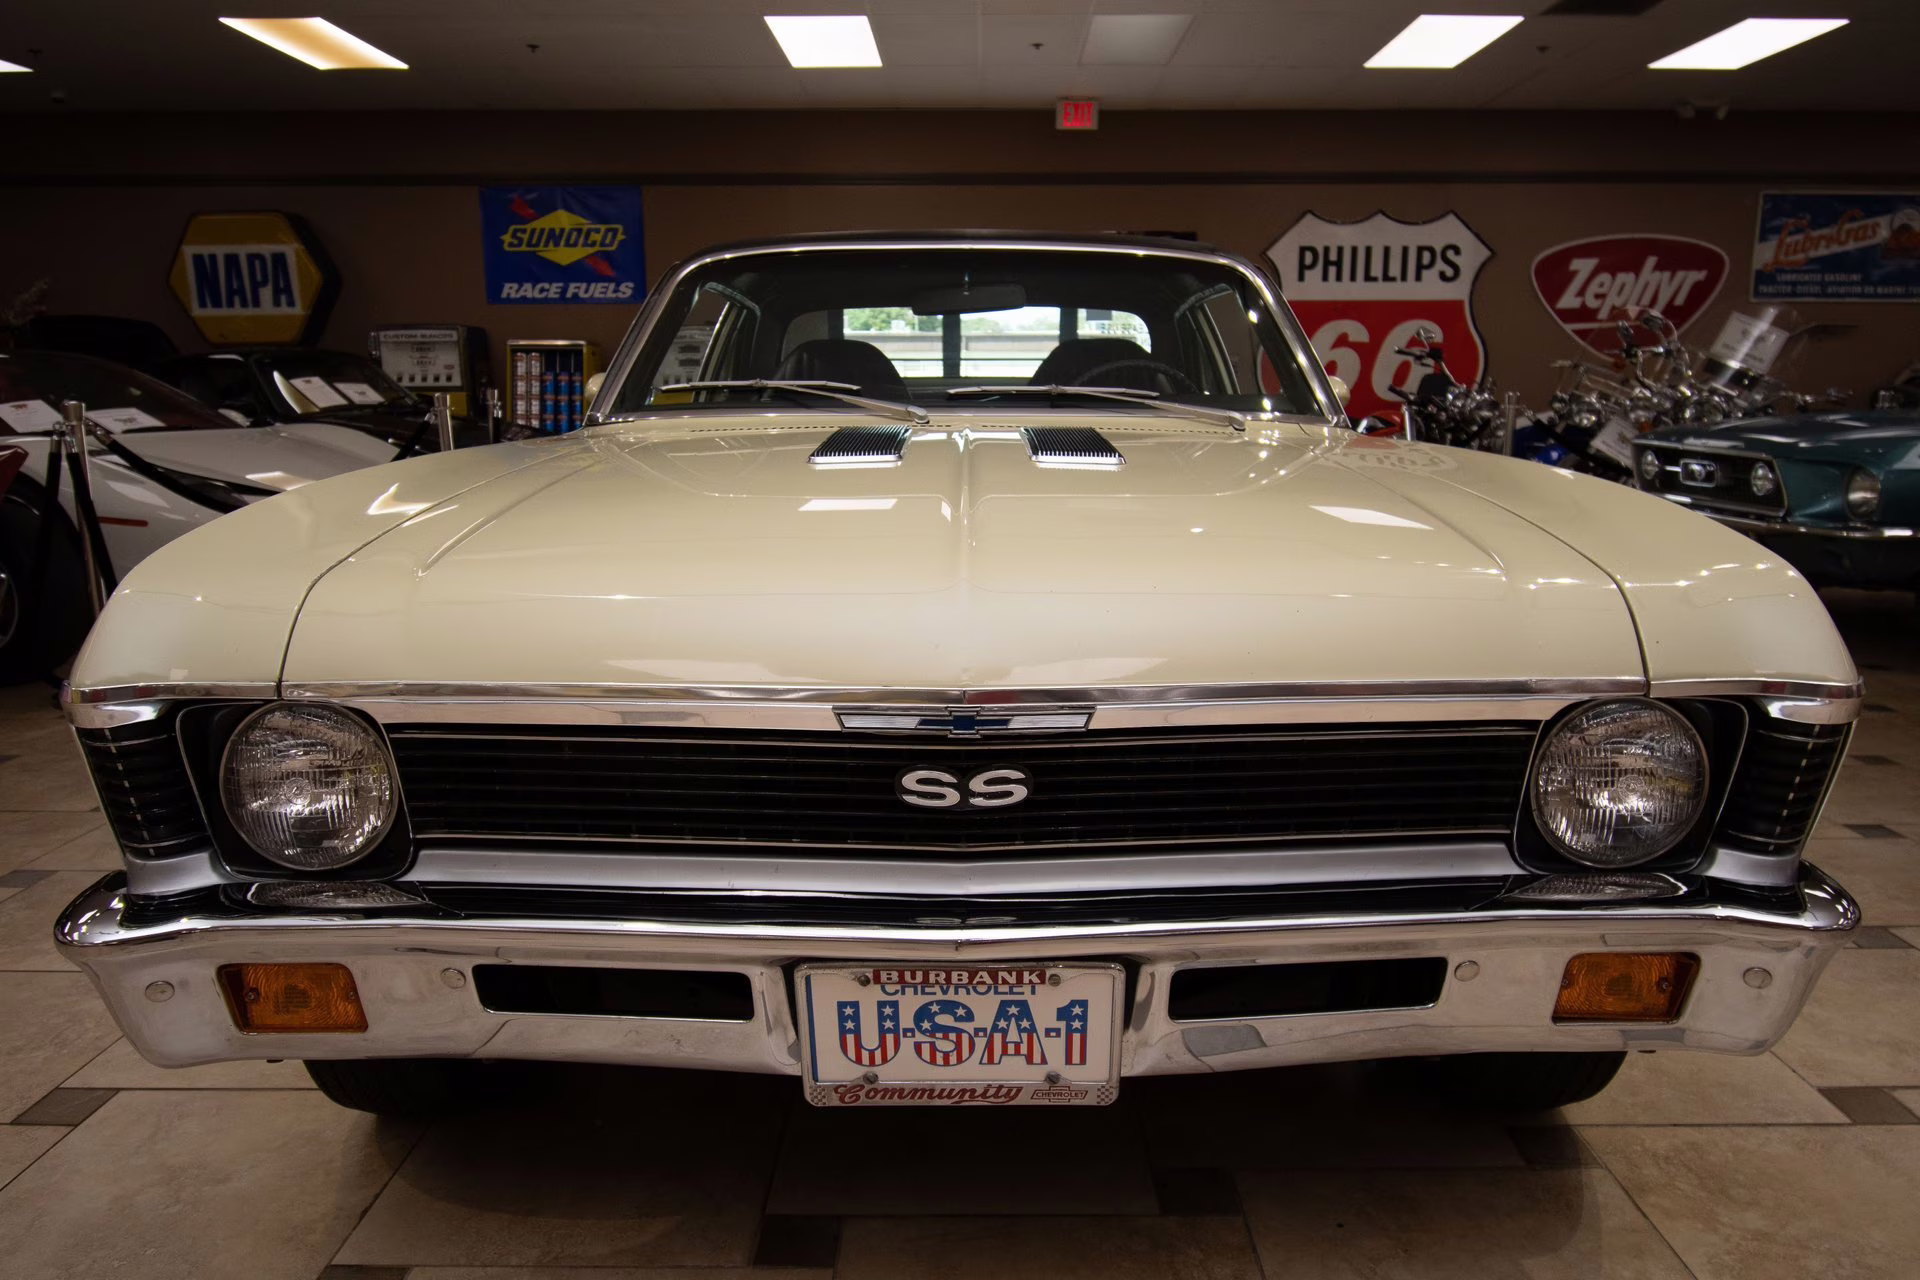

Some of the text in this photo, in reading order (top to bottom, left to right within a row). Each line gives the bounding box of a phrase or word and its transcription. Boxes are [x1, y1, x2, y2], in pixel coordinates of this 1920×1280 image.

[1063, 101, 1093, 128] EXIT
[507, 226, 620, 249] SUNOCO
[1297, 244, 1463, 284] PHILLIPS
[191, 251, 297, 309] NAPA
[500, 281, 635, 299] RACE FUELS
[1555, 255, 1708, 320] Zephyr
[1309, 318, 1445, 410] 66
[901, 769, 1029, 807] SS
[880, 970, 1042, 985] BURBANK
[880, 983, 1037, 996] CHEVROLET
[833, 1083, 1084, 1105] Community CHEVROLET
